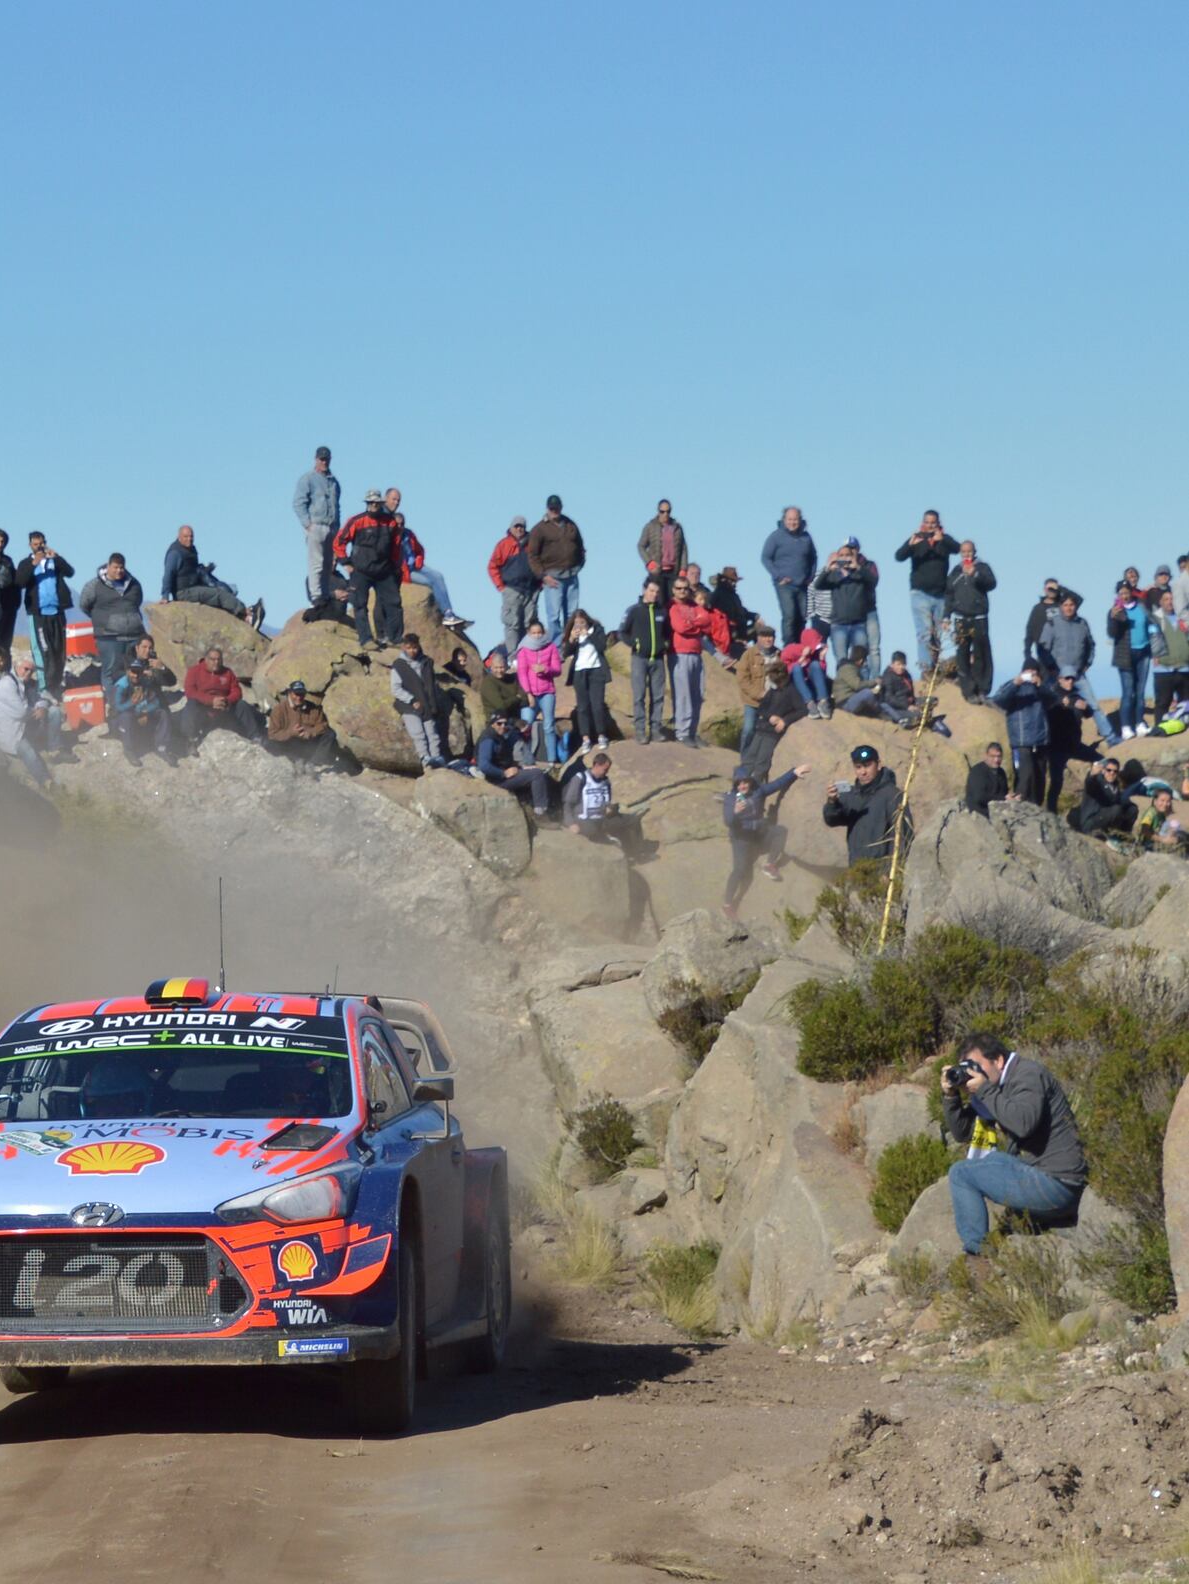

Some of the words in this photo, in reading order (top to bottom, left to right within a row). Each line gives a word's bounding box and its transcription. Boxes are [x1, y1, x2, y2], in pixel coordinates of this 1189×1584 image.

[102, 1013, 236, 1028] HYUNDAI
[181, 1033, 226, 1045] ALL
[233, 1034, 286, 1047] LIVE
[48, 1122, 176, 1130] HYUNDAI
[82, 1127, 254, 1140] MOBIS
[273, 1300, 312, 1308] HYUNDAI
[288, 1305, 328, 1324] WIA
[299, 1343, 344, 1351] MICHELIN
